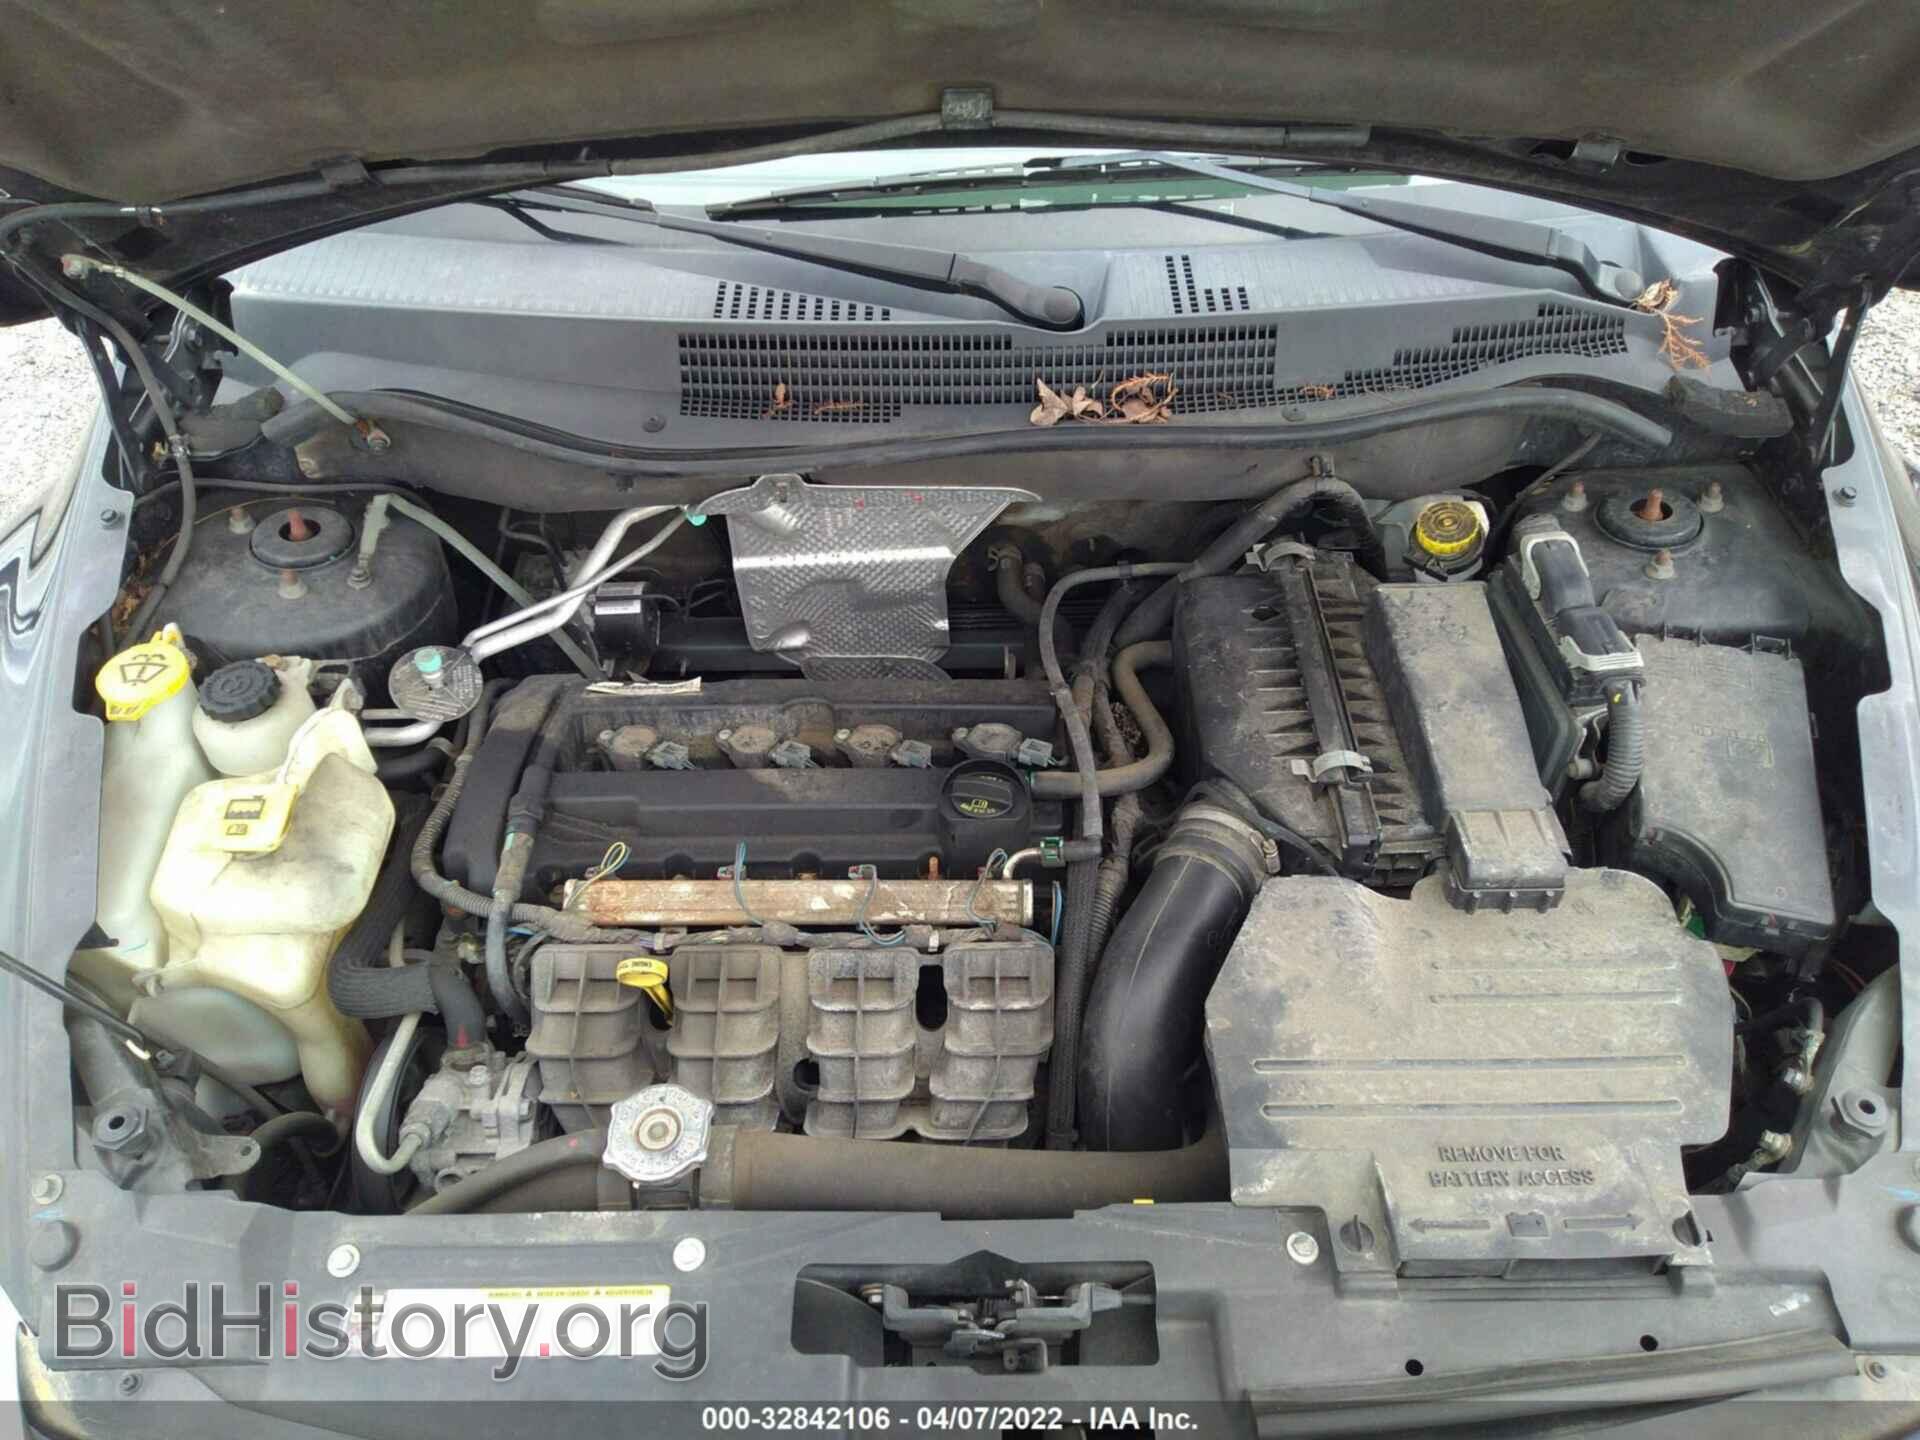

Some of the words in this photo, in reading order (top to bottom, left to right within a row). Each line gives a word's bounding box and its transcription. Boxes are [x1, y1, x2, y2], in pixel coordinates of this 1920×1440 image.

[1438, 1146, 1520, 1162] REMOVE
[1524, 1146, 1566, 1161] FOR
[1428, 1170, 1510, 1187] BATTERY
[1517, 1169, 1596, 1186] ACCESS
